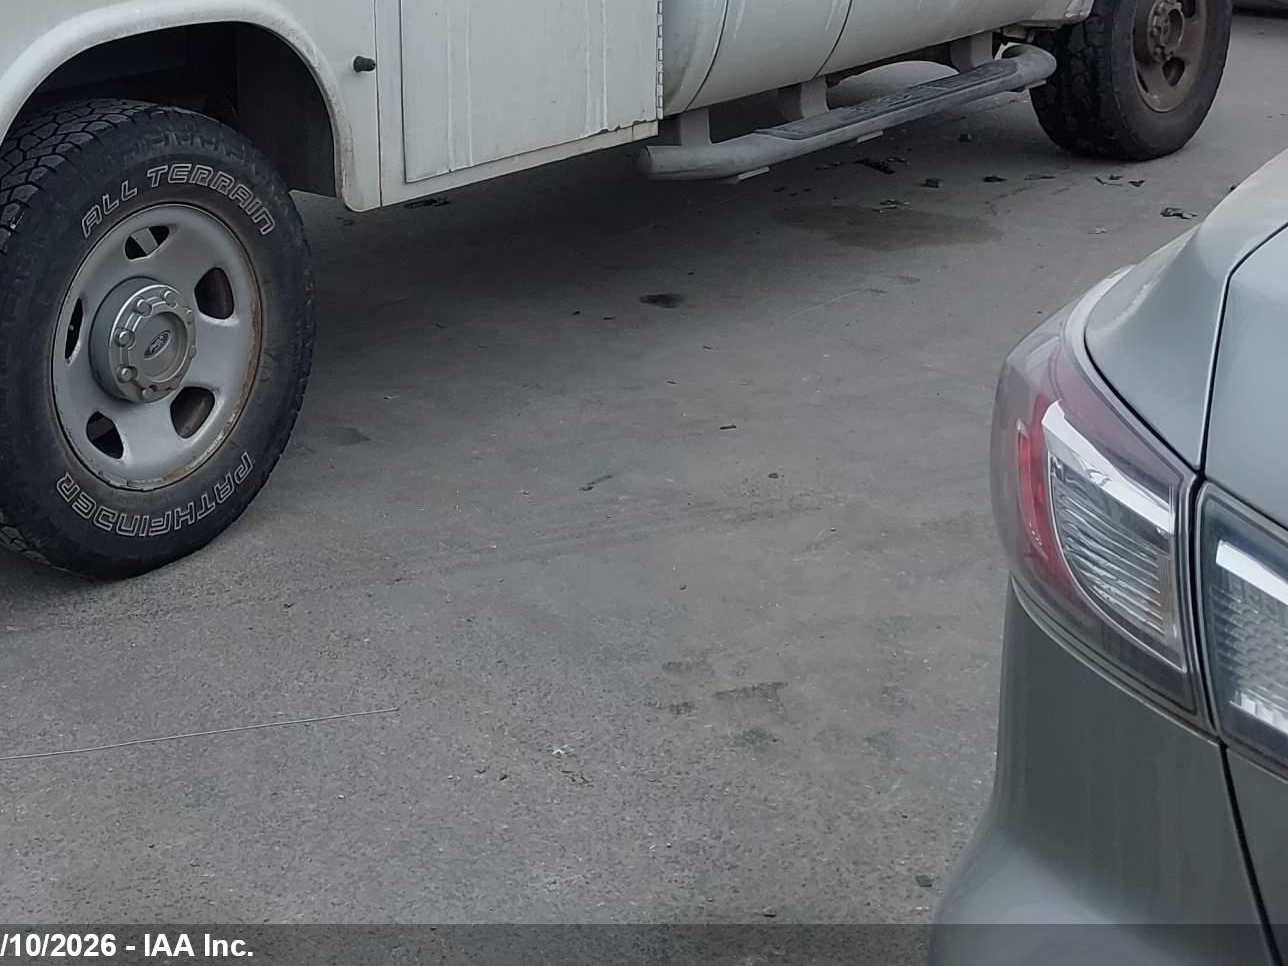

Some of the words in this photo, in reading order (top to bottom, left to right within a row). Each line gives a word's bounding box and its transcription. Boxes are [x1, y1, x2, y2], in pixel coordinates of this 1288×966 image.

[81, 180, 138, 239] ALL
[146, 163, 276, 235] TERRAIN
[56, 451, 256, 538] PATHFINDER
